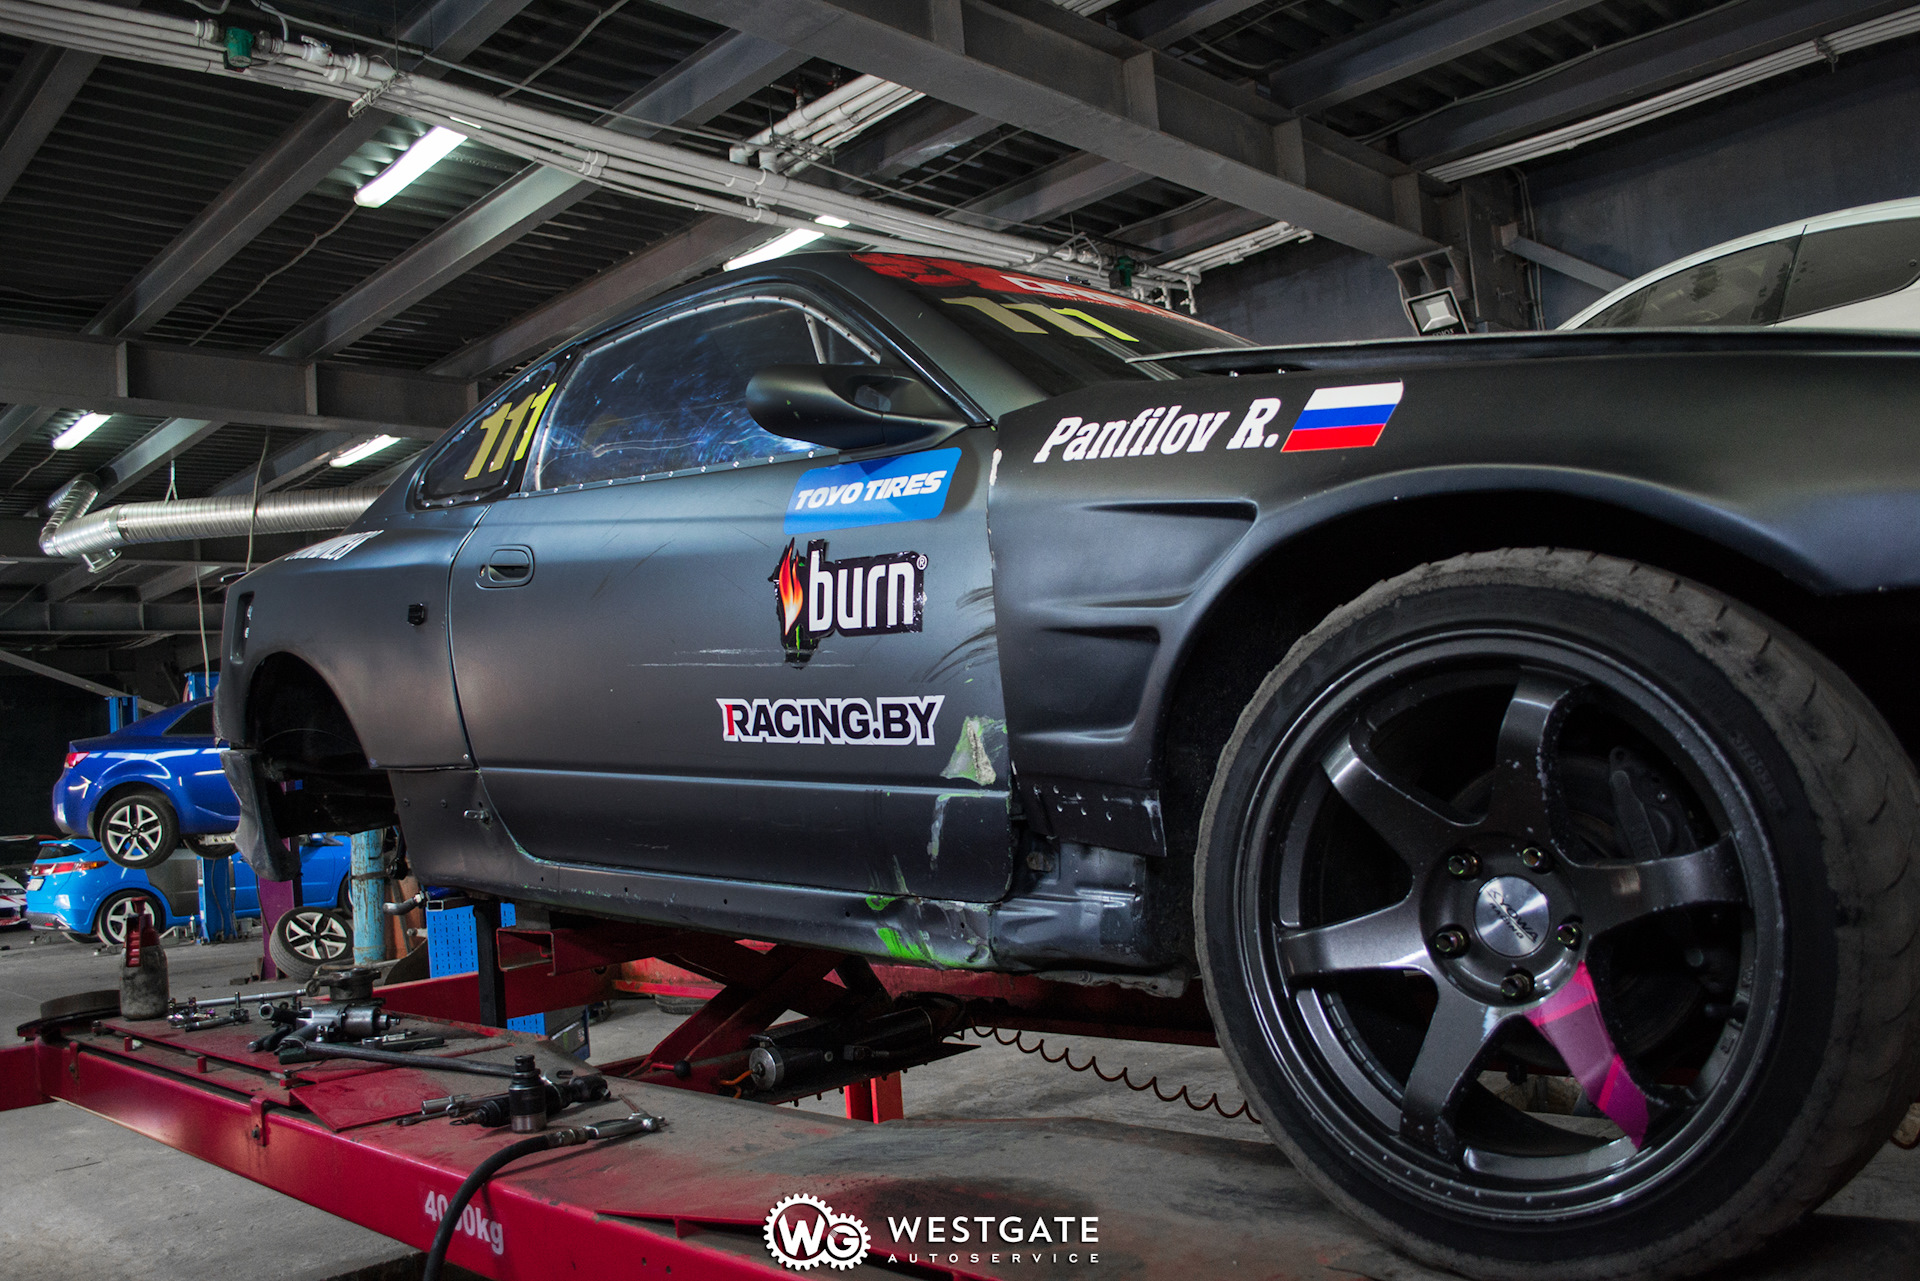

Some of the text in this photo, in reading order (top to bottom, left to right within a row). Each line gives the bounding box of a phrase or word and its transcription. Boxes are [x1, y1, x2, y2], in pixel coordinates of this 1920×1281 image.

[464, 382, 557, 481] 111
[1033, 398, 1282, 463] Panfilov R.
[795, 470, 948, 511] TOYO TIRES
[723, 701, 937, 740] RACING.BY
[425, 1190, 504, 1255] 400kg
